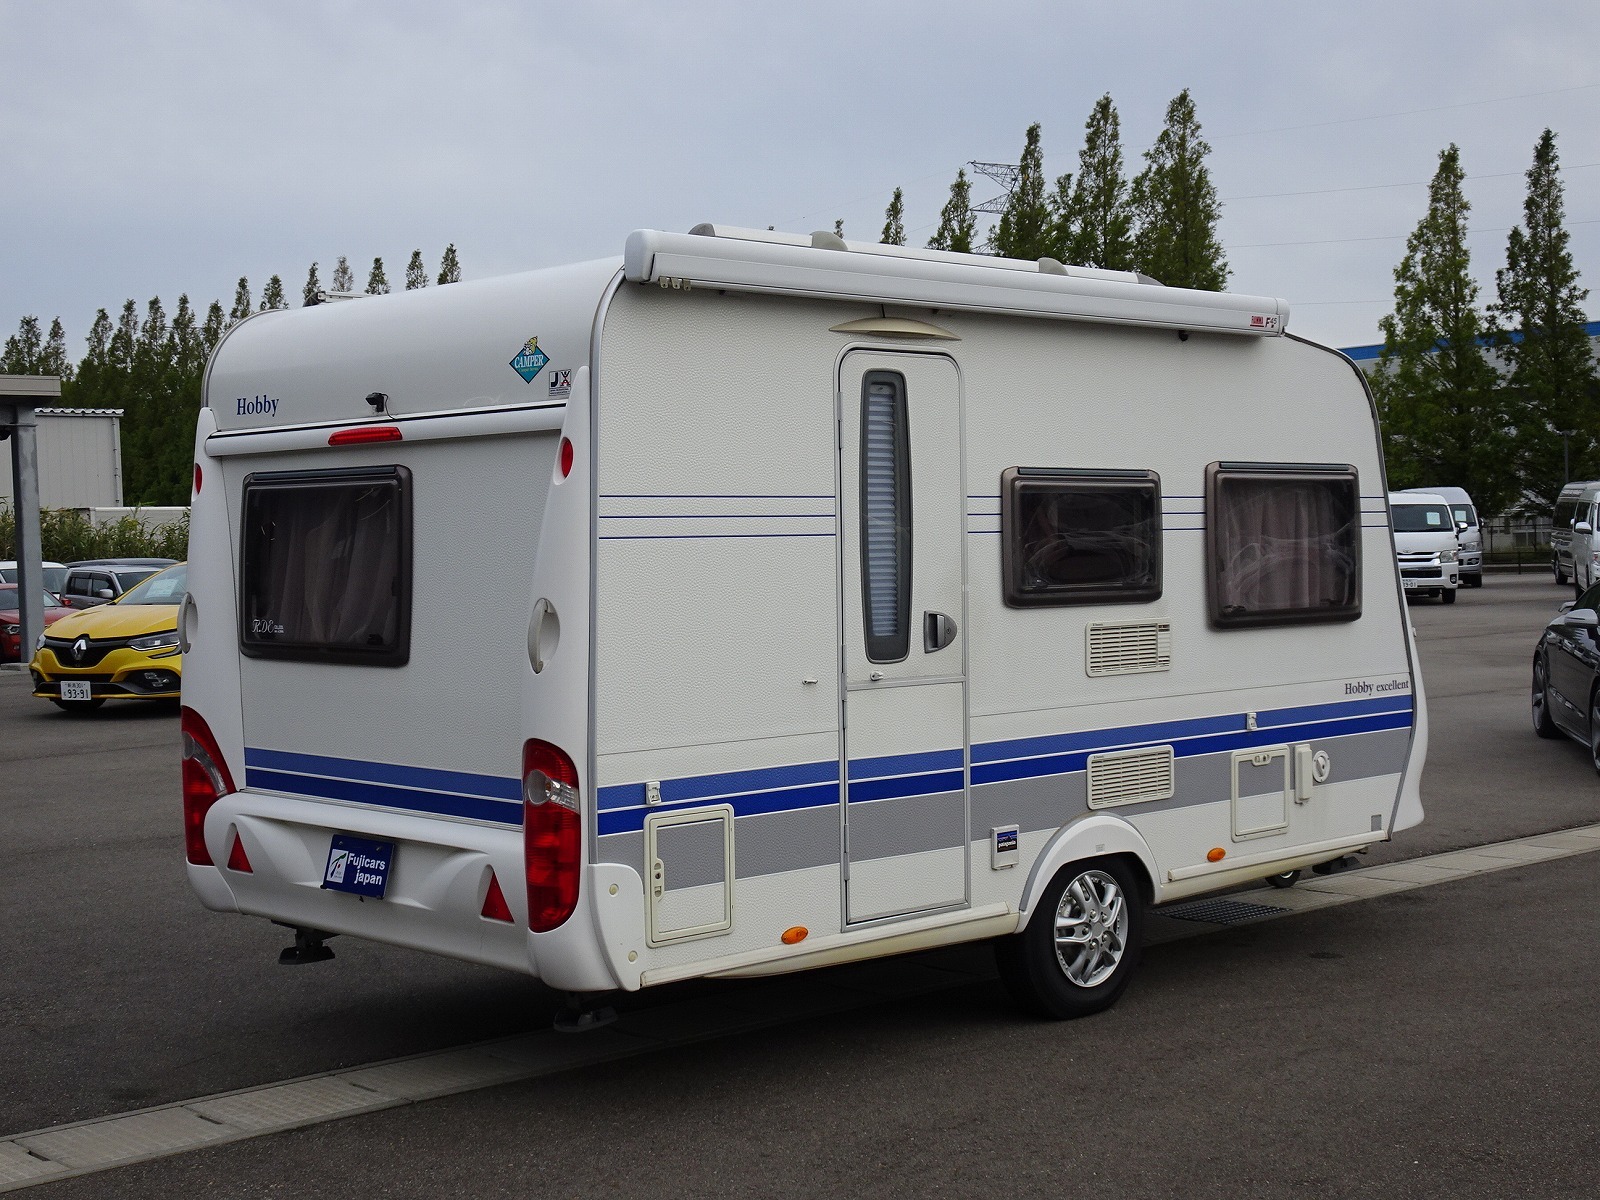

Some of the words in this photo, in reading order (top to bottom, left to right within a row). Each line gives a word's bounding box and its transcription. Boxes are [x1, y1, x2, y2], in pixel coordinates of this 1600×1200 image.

[514, 354, 544, 369] CAMPER
[236, 394, 280, 418] Hobby
[67, 688, 89, 699] 93-91
[1344, 681, 1374, 696] Hobby
[1376, 680, 1409, 692] excellent
[347, 852, 386, 871] Fujicars
[353, 868, 383, 886] japan
